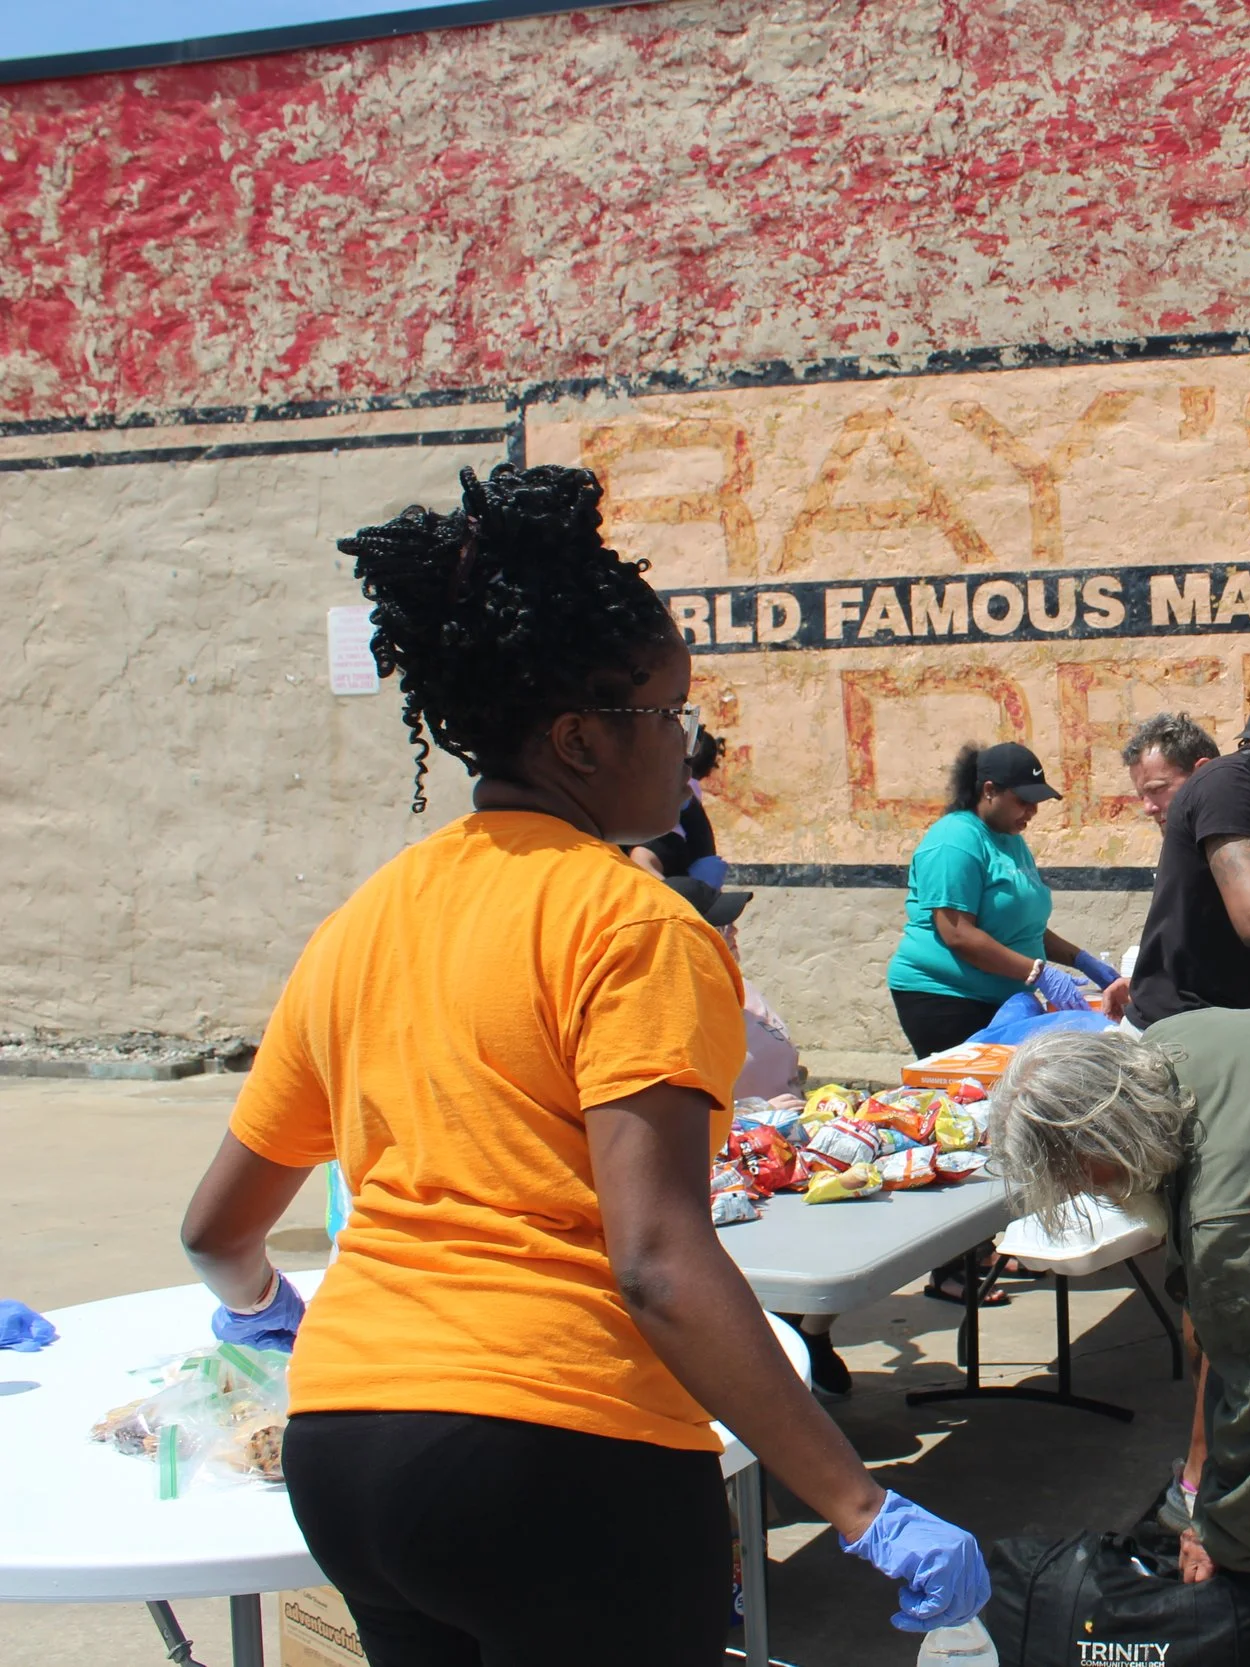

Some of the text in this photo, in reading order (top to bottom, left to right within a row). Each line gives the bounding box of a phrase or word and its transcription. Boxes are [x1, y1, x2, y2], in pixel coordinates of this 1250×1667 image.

[669, 590, 802, 647] RLD
[824, 574, 1127, 640] FAMOUS
[284, 1602, 364, 1657] adventurefuls
[1077, 1641, 1170, 1662] TRINITY
